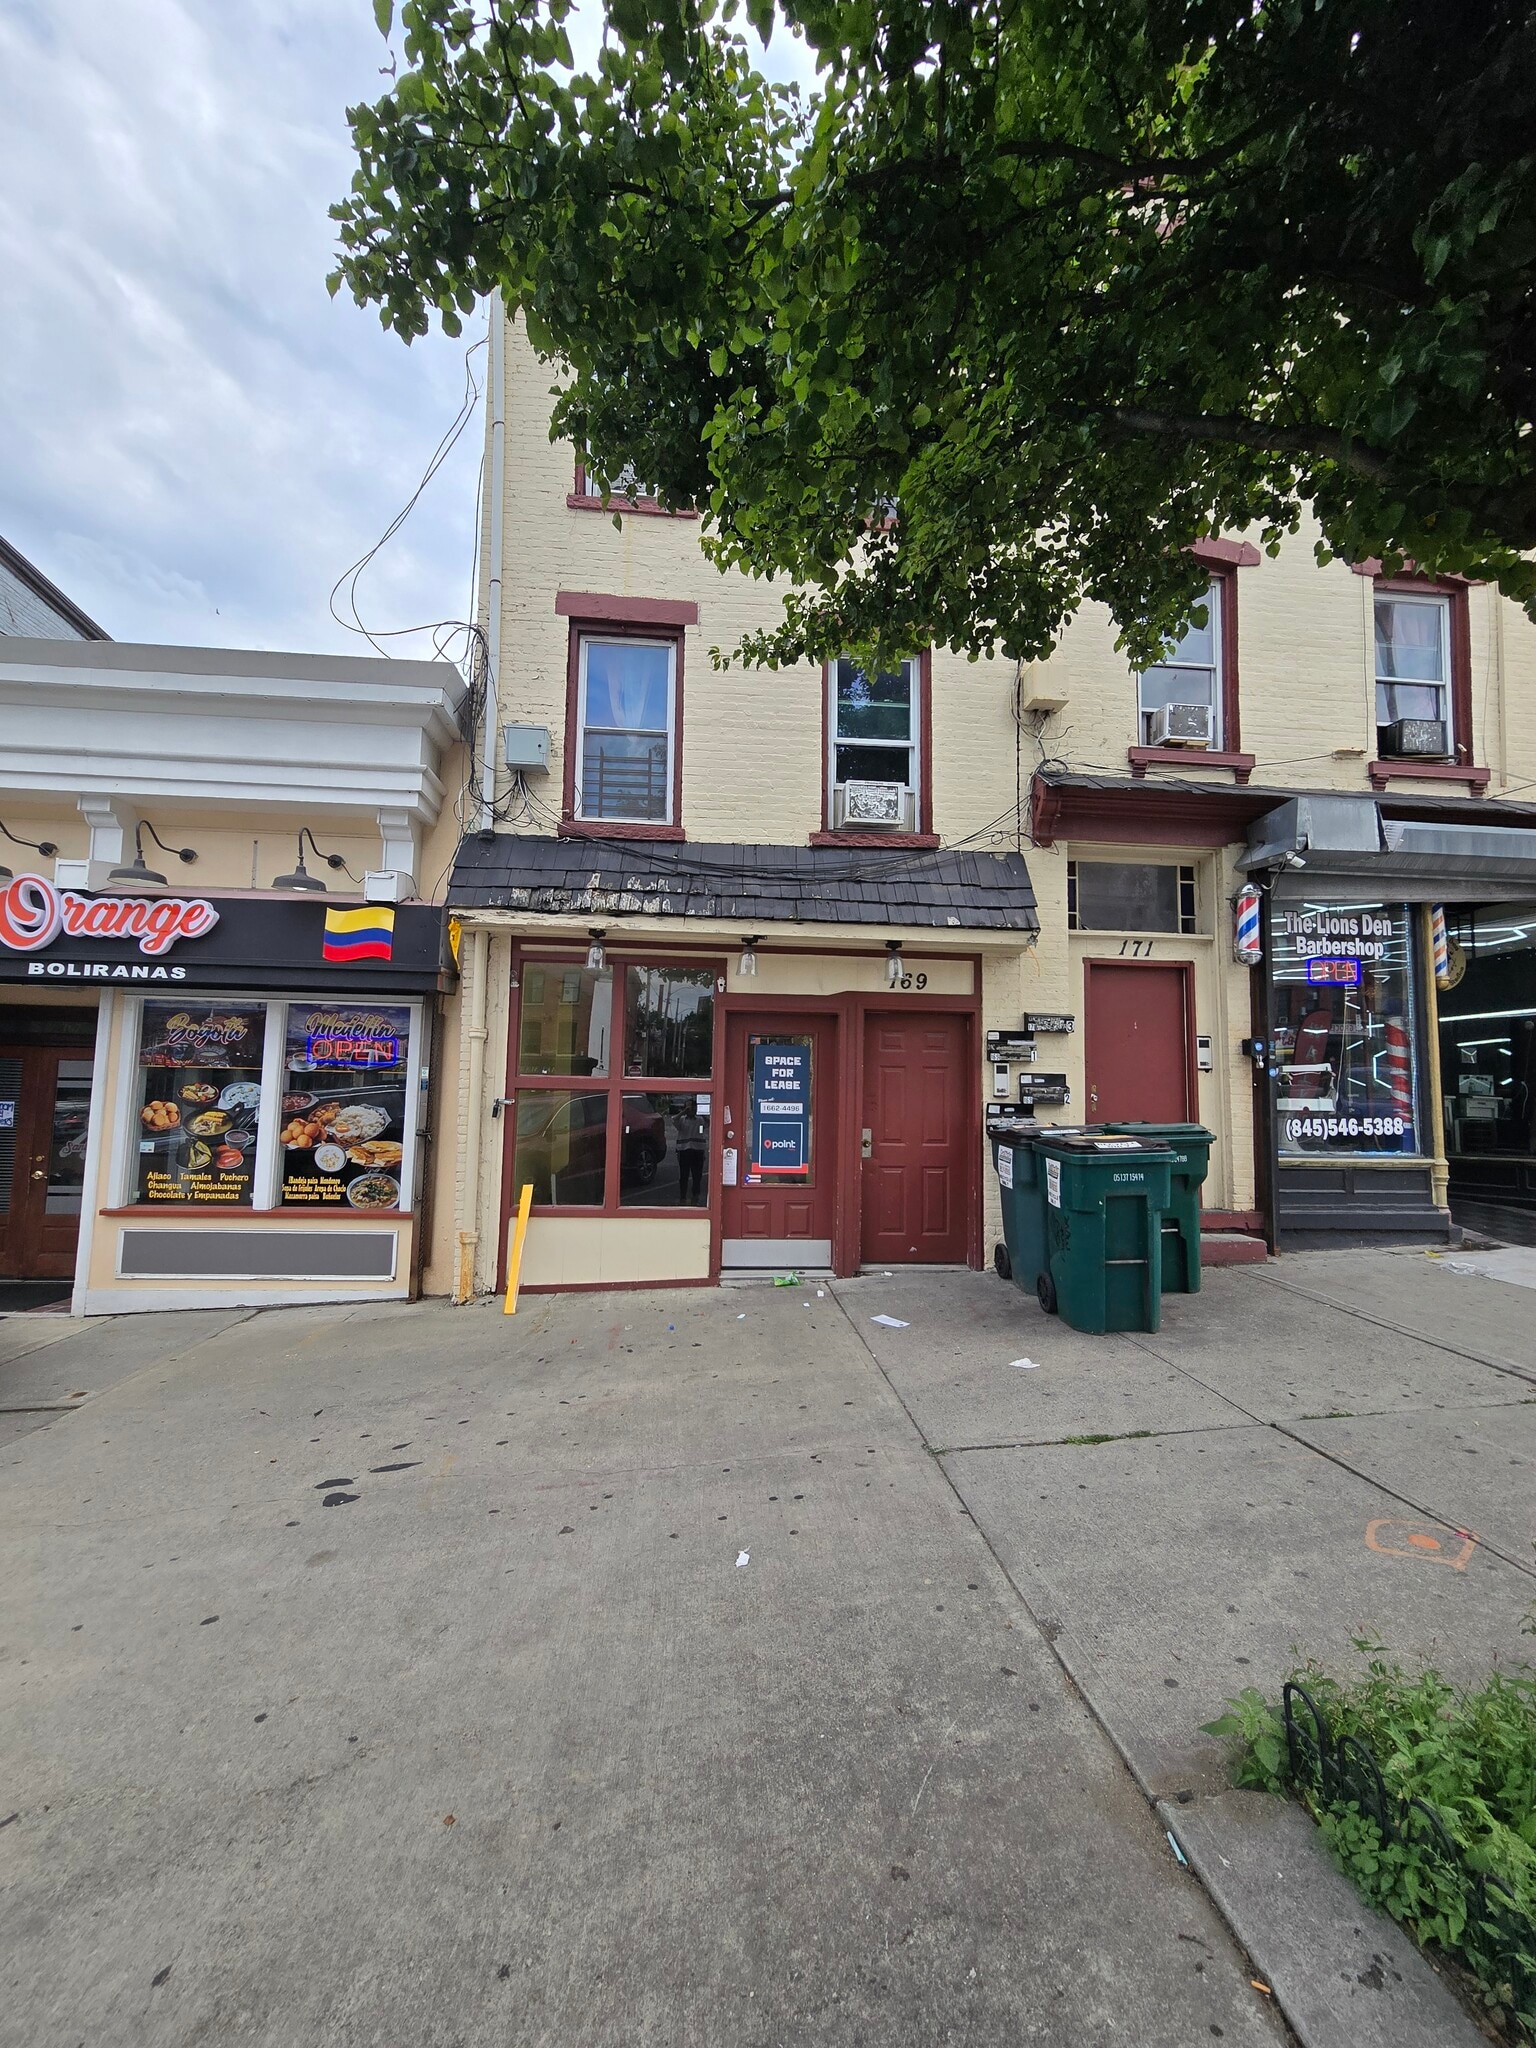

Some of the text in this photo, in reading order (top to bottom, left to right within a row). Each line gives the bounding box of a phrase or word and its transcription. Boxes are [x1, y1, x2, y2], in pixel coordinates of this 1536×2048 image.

[0, 873, 217, 954] Orange
[1284, 911, 1392, 936] The Lions Den
[1119, 940, 1153, 957] 171
[1296, 936, 1384, 959] Barbershop
[28, 962, 187, 980] BOLIRANAS
[1310, 961, 1357, 981] OPEN
[889, 973, 928, 990] 169
[1067, 1021, 1074, 1032] 3
[312, 1039, 393, 1061] OPEN
[765, 1056, 802, 1066] SPACE
[772, 1068, 794, 1078] FOR
[764, 1080, 801, 1090] LEASE
[1065, 1094, 1071, 1104] 2
[1286, 1117, 1404, 1140] (845)546-5388
[772, 1140, 796, 1149] point
[147, 1172, 249, 1182] Ajiaco Tamales Puchero
[148, 1181, 182, 1190] Changua
[148, 1190, 239, 1200] Chocolate y Empanadas
